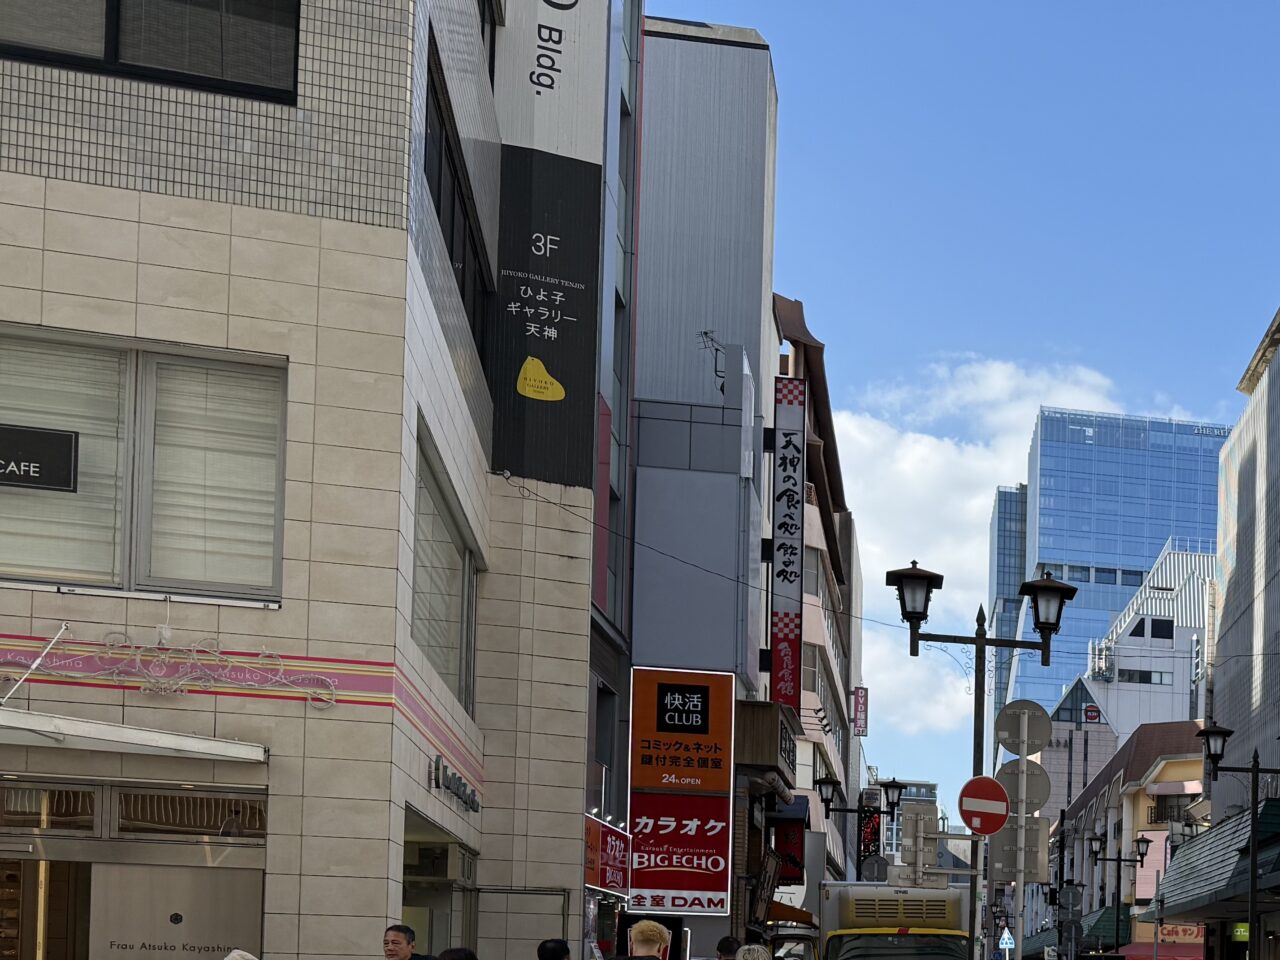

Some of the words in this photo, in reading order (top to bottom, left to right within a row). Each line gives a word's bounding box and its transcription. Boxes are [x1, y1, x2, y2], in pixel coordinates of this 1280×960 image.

[529, 23, 563, 96] Bldg.
[531, 233, 560, 257] 3F
[501, 269, 528, 278] HIYOKO
[529, 273, 559, 285] GALLERY
[560, 280, 585, 290] TENJIN
[520, 286, 566, 304] ひよ子
[507, 302, 577, 322] ギャラリー
[525, 322, 558, 341] 天神
[664, 692, 702, 711] 快活
[665, 712, 702, 726] CLUB
[640, 739, 722, 754] コミック&ネット
[633, 816, 726, 836] カラオケ
[632, 853, 669, 870] BIG
[672, 855, 726, 872] ECHO
[631, 894, 666, 907] 全室
[671, 896, 725, 908] DAM
[109, 941, 135, 950] Frau
[140, 942, 176, 951] Atsuko
